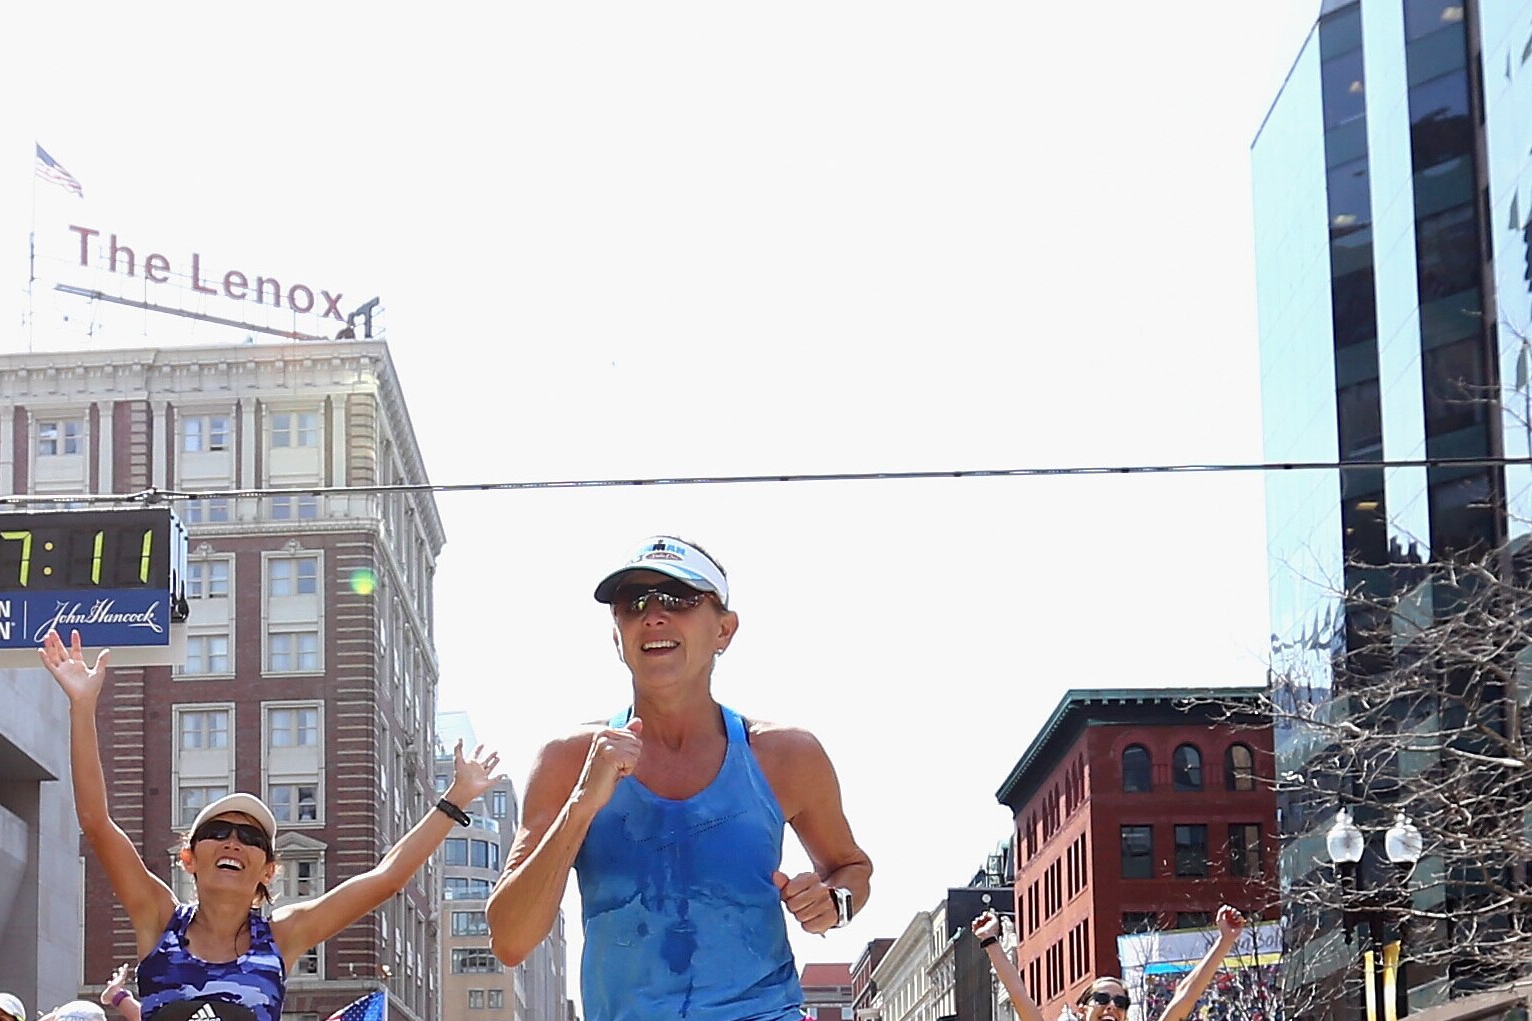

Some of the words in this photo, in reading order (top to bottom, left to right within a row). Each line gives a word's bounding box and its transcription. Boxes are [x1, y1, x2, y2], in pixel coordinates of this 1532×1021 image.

[69, 224, 171, 284] The
[190, 252, 344, 321] Lenox
[33, 599, 88, 643] John
[82, 598, 164, 634] Hancock
